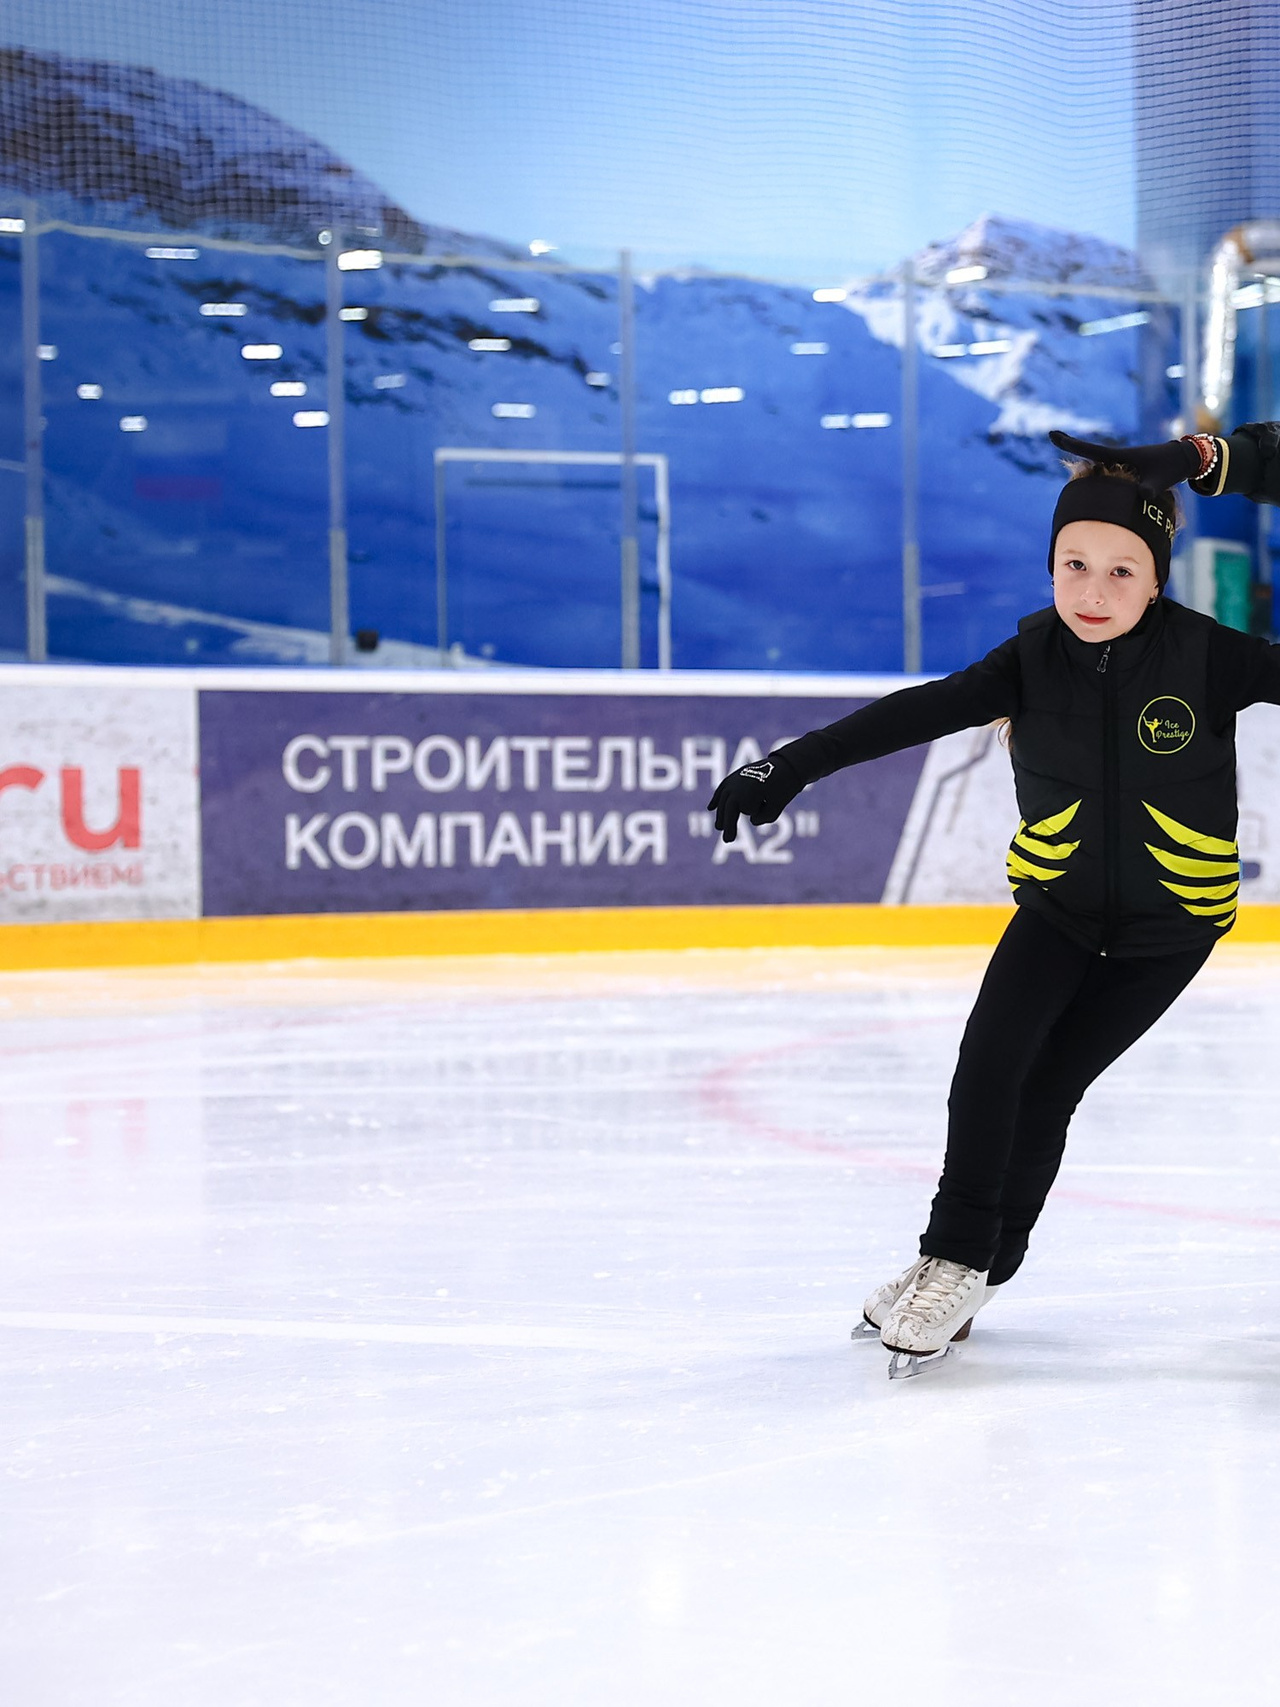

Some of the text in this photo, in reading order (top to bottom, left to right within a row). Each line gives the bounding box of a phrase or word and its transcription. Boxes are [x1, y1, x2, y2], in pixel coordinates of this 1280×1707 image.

[1143, 500, 1164, 527] ICE
[1156, 729, 1190, 742] Prestige
[1164, 719, 1180, 729] Ice
[282, 734, 812, 792] СТРОИТЕЛЬНА
[285, 811, 668, 869] КОМПАНИЯ
